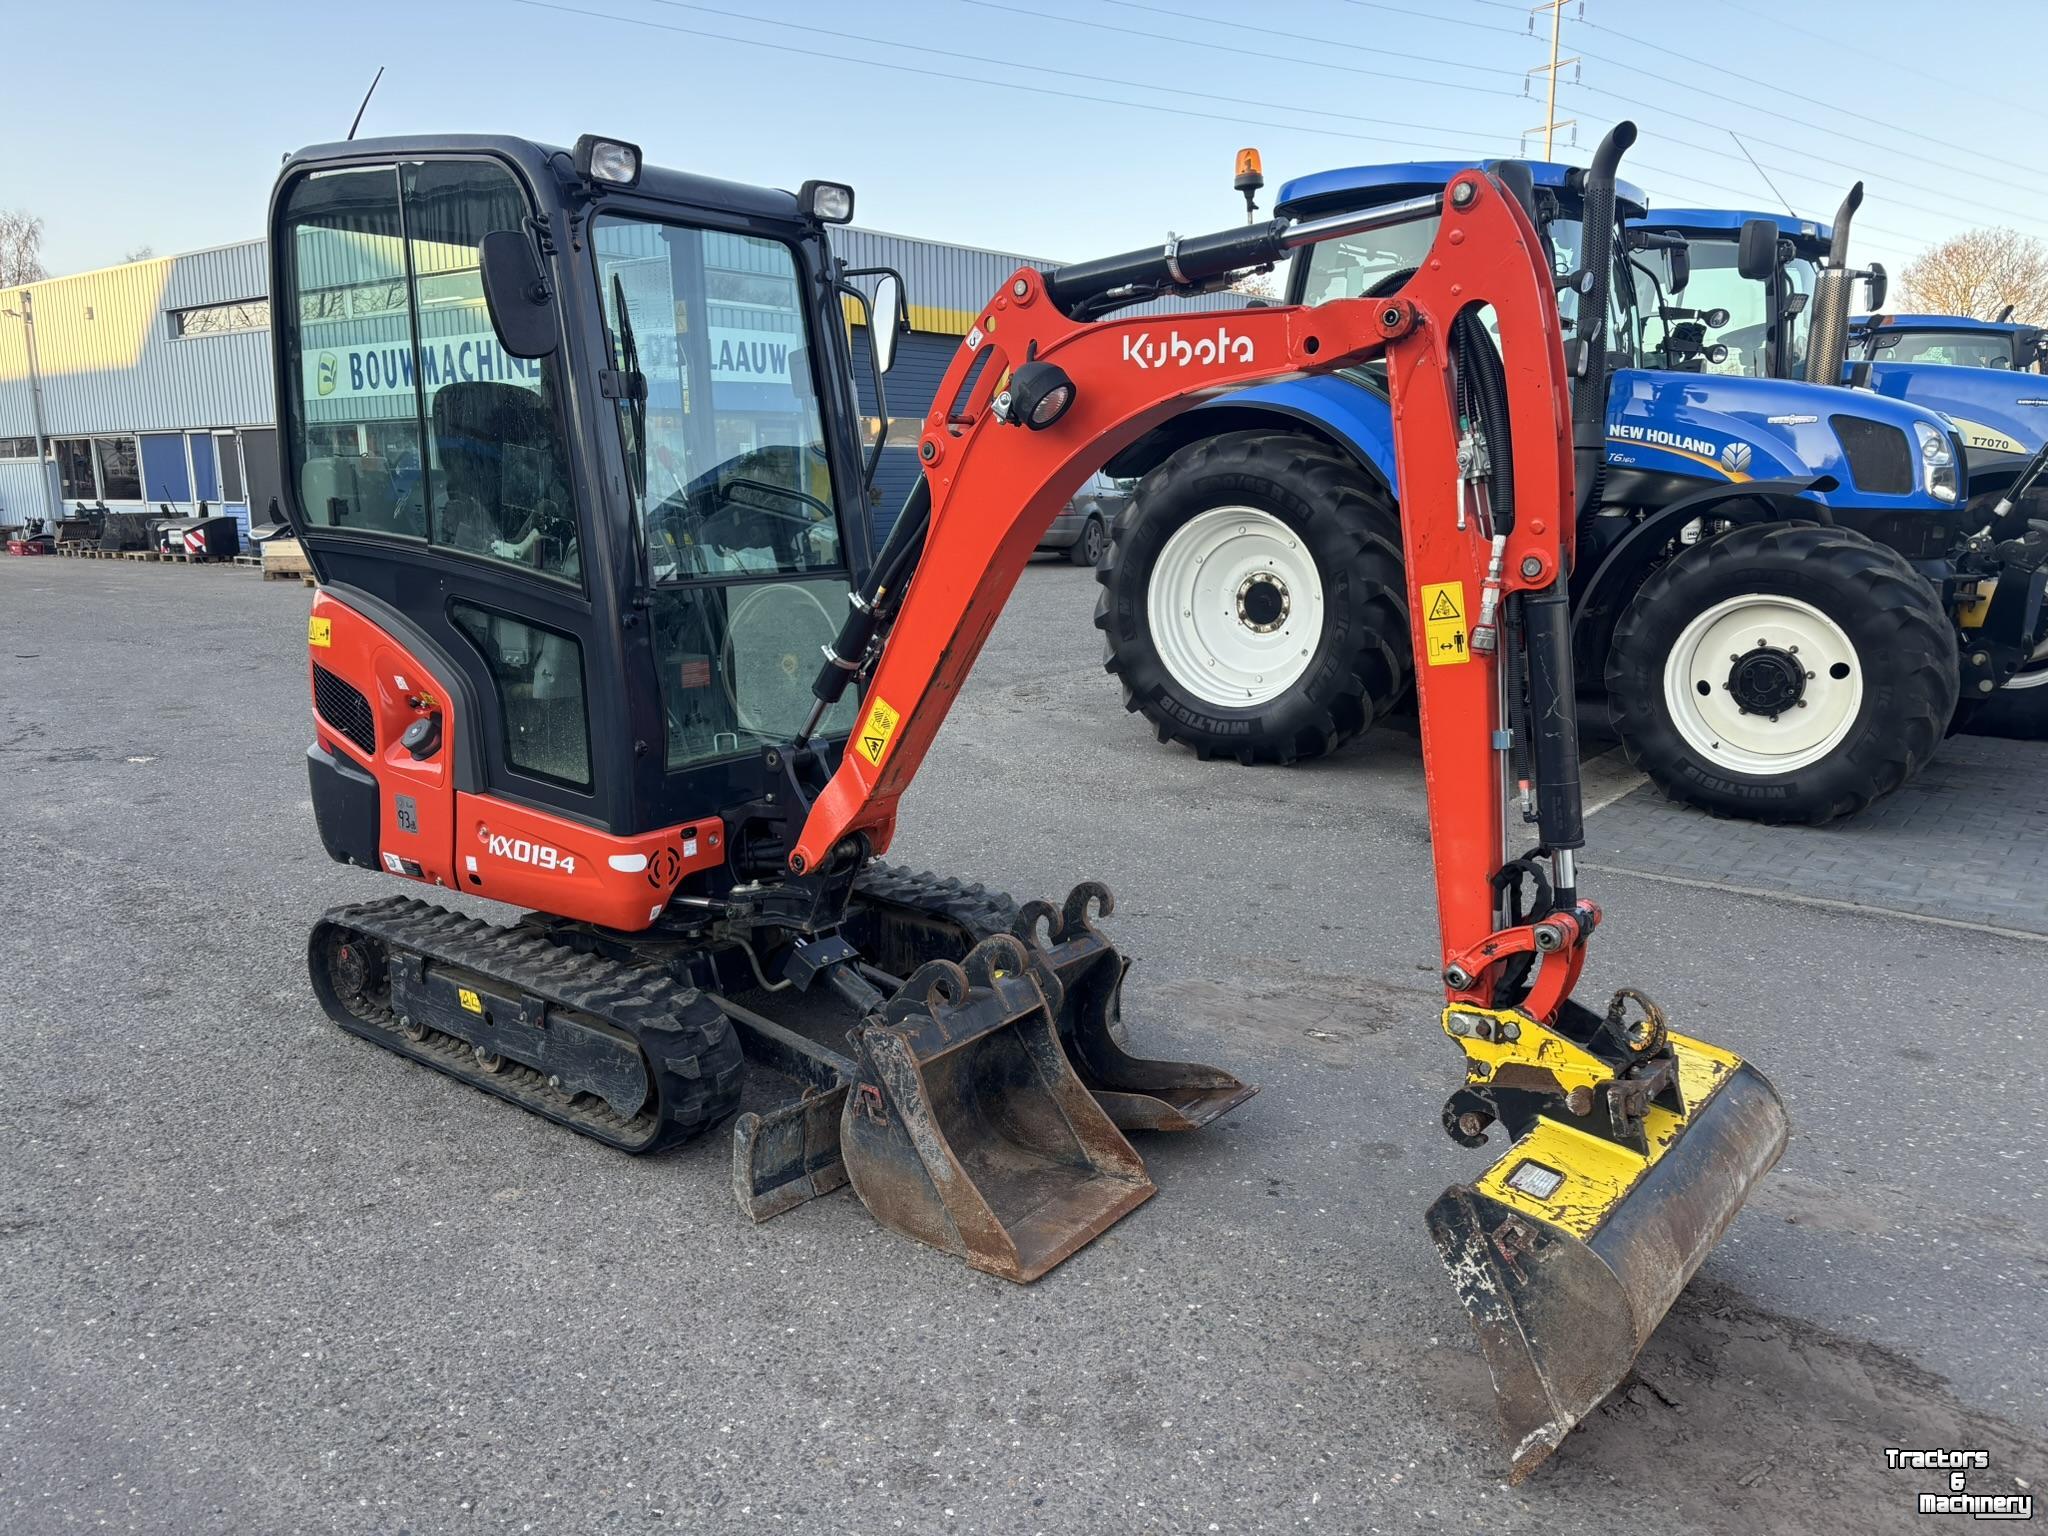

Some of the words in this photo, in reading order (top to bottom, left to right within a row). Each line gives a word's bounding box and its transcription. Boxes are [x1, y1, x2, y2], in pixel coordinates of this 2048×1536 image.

[1122, 327, 1254, 369] Kubota
[1609, 424, 1645, 439] NEW
[1646, 429, 1716, 457] HOLLAND
[1972, 436, 2009, 450] T7070
[1159, 695, 1251, 735] MULTIBIB
